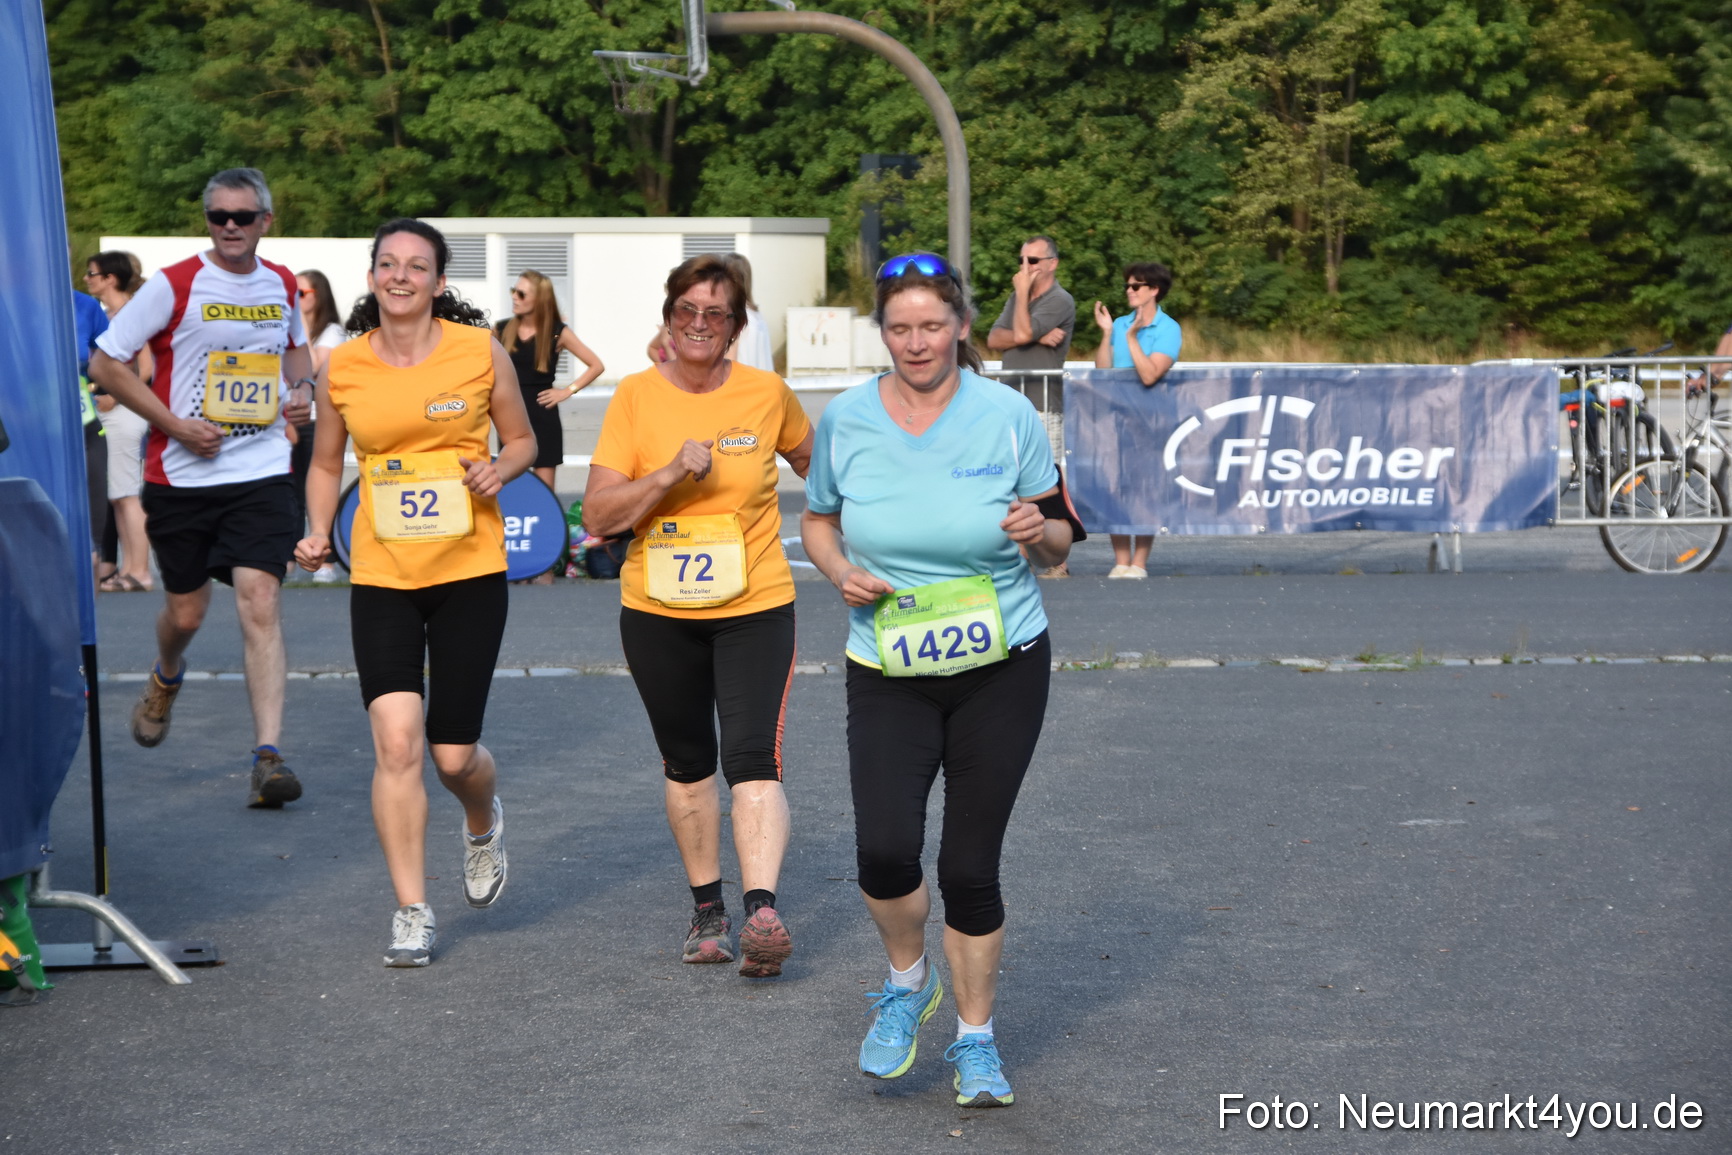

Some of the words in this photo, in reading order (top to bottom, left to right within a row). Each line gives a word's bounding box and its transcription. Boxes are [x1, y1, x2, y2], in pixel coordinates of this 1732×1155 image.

[206, 304, 279, 318] ONLINE
[214, 380, 272, 405] 1021
[965, 462, 1004, 477] sumida
[1215, 435, 1456, 483] Fischer
[399, 489, 440, 519] 52
[1237, 486, 1436, 508] AUTOMOBILE
[656, 530, 691, 539] firmenlauf
[673, 552, 714, 583] 72
[891, 602, 934, 618] firmenlauf
[891, 620, 992, 668] 1429
[939, 661, 978, 675] Huthmann
